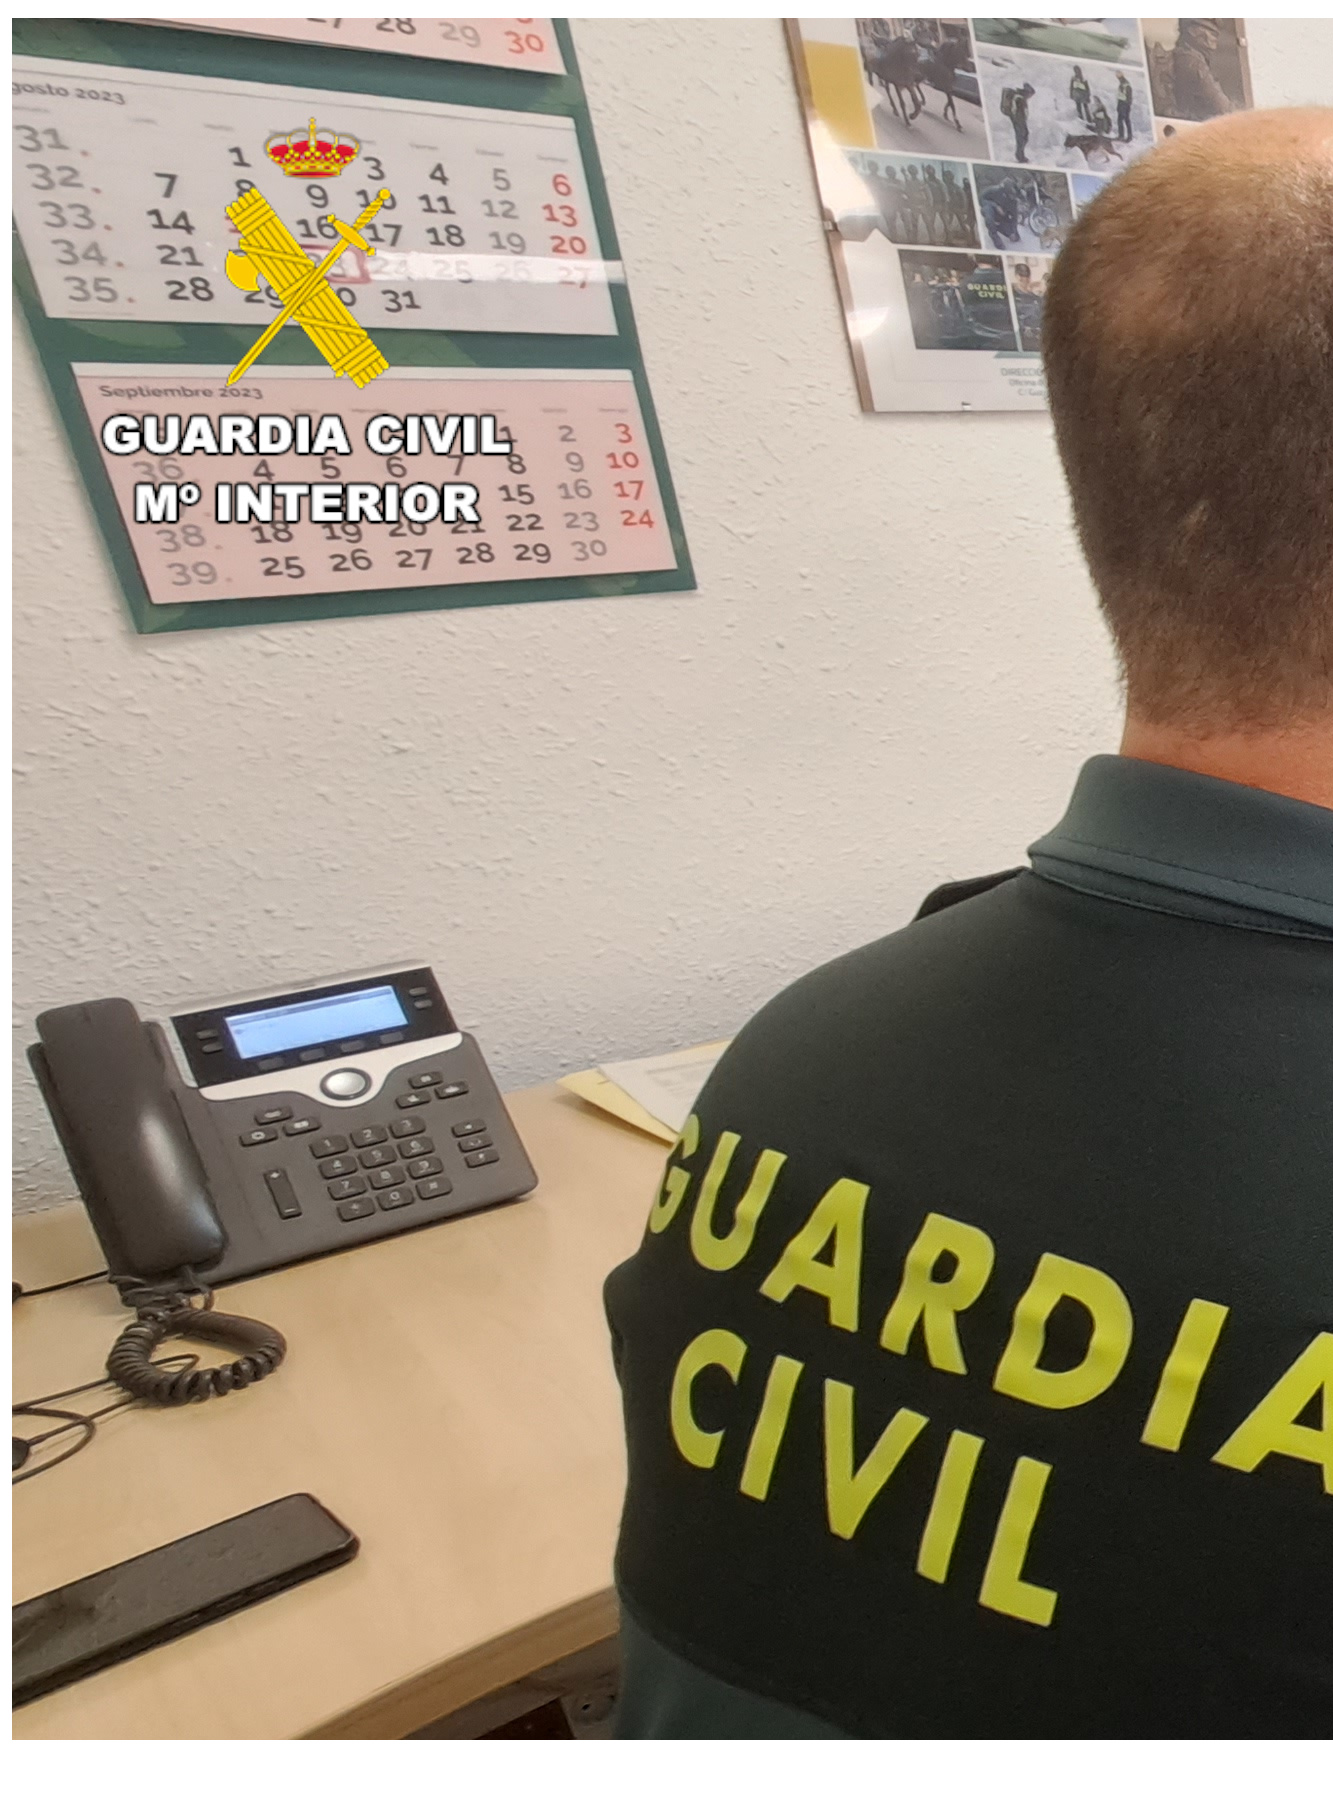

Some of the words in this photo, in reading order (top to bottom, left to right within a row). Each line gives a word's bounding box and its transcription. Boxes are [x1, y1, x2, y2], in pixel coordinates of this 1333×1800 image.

[439, 22, 481, 48] 29
[504, 31, 544, 54] 30
[75, 88, 125, 105] 2023
[228, 147, 252, 168] 1
[363, 157, 385, 181] 3
[429, 163, 449, 186] 4
[493, 168, 511, 191] 5
[552, 174, 572, 197] 6
[154, 172, 178, 199] 7
[306, 184, 329, 208] 9
[418, 194, 456, 214] 11
[481, 199, 519, 219] 12
[542, 204, 577, 227] 13
[147, 209, 195, 235] 14
[296, 215, 338, 239] 16
[365, 223, 403, 247] 17
[426, 225, 466, 247] 18
[488, 231, 526, 254] 19
[549, 235, 587, 255] 20
[156, 244, 204, 267] 21
[165, 277, 214, 302] 28
[381, 290, 421, 313] 31
[99, 385, 213, 399] Septiembre
[219, 387, 263, 400] 2023
[558, 425, 577, 442] 2
[614, 423, 633, 444] 3
[253, 459, 275, 481] 4
[321, 456, 341, 479] 5
[386, 456, 407, 478] 6
[448, 455, 465, 476] 7
[507, 453, 527, 474] 8
[565, 452, 584, 473] 9
[606, 451, 639, 469] 10
[499, 484, 534, 505] 15
[558, 479, 592, 500] 16
[613, 480, 644, 500] 17
[251, 521, 294, 544] 18
[321, 522, 363, 544] 19
[506, 514, 545, 532] 22
[564, 511, 599, 532] 23
[620, 509, 655, 529] 24
[260, 556, 305, 579] 25
[329, 548, 373, 572] 26
[396, 549, 433, 571] 27
[456, 542, 495, 565] 28
[513, 543, 552, 564] 29
[571, 540, 608, 561] 30
[669, 1328, 1059, 1628] CIVIL
